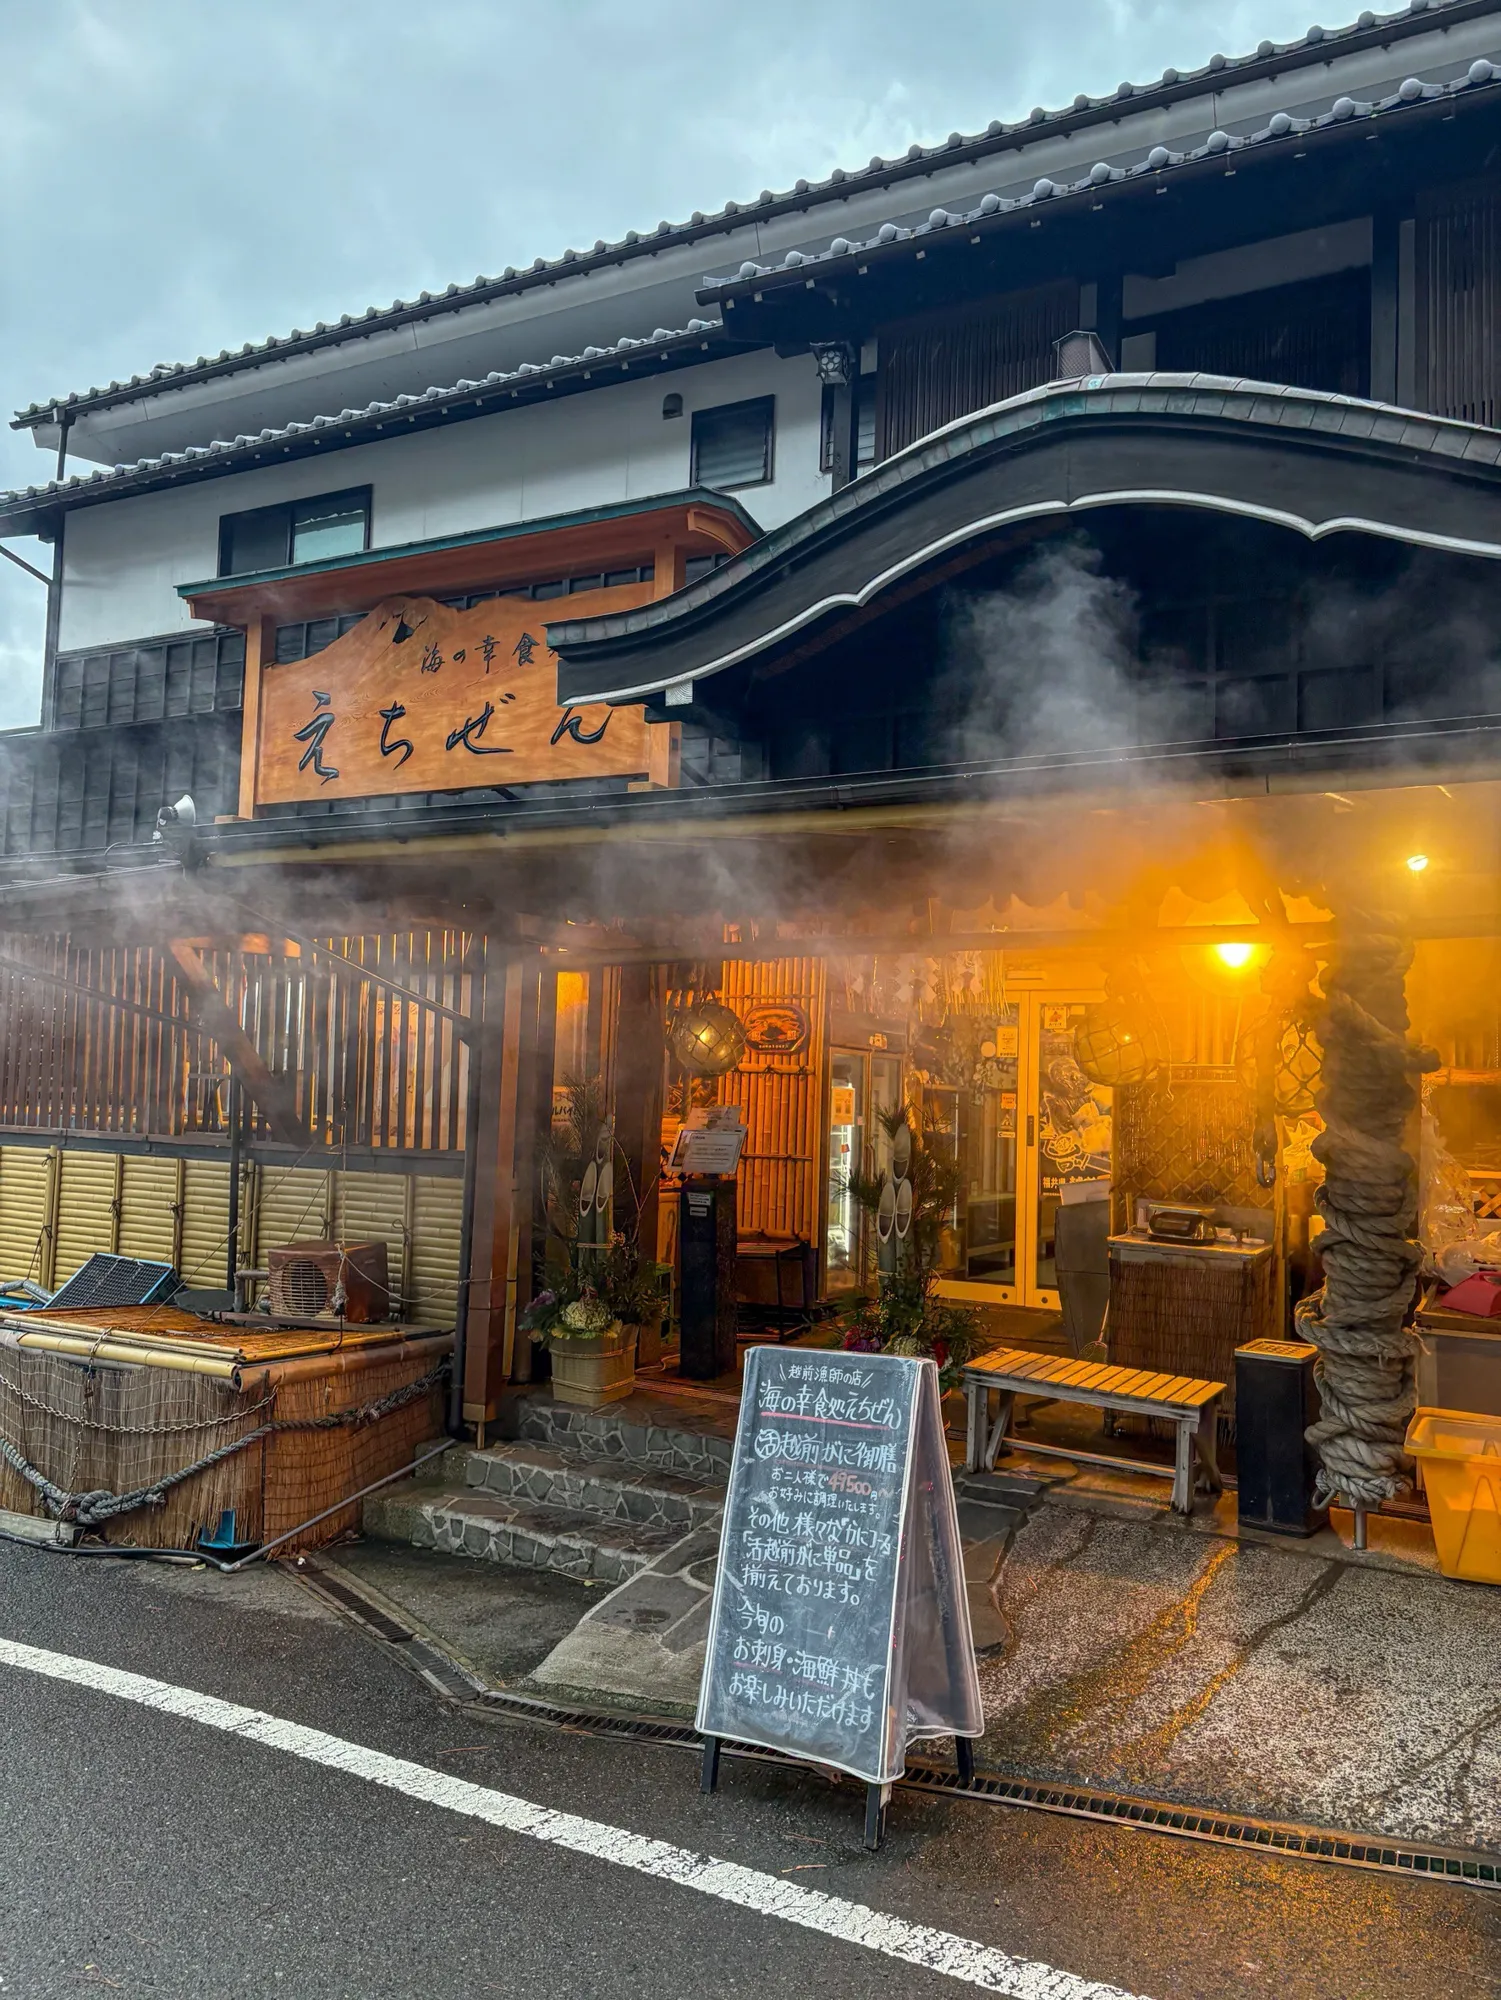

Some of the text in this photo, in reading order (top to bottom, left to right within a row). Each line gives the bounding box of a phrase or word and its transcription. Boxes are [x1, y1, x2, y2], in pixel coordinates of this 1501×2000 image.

[420, 632, 559, 674] 海の幸食
[293, 690, 614, 786] えちぜん
[788, 1364, 864, 1388] 越前漁師の店
[758, 1379, 902, 1431] 海の幸食処えちぜん
[741, 1563, 860, 1606] 揃えております。
[737, 1595, 785, 1636] 今旬の
[729, 1672, 876, 1734] お楽しみいただけます
